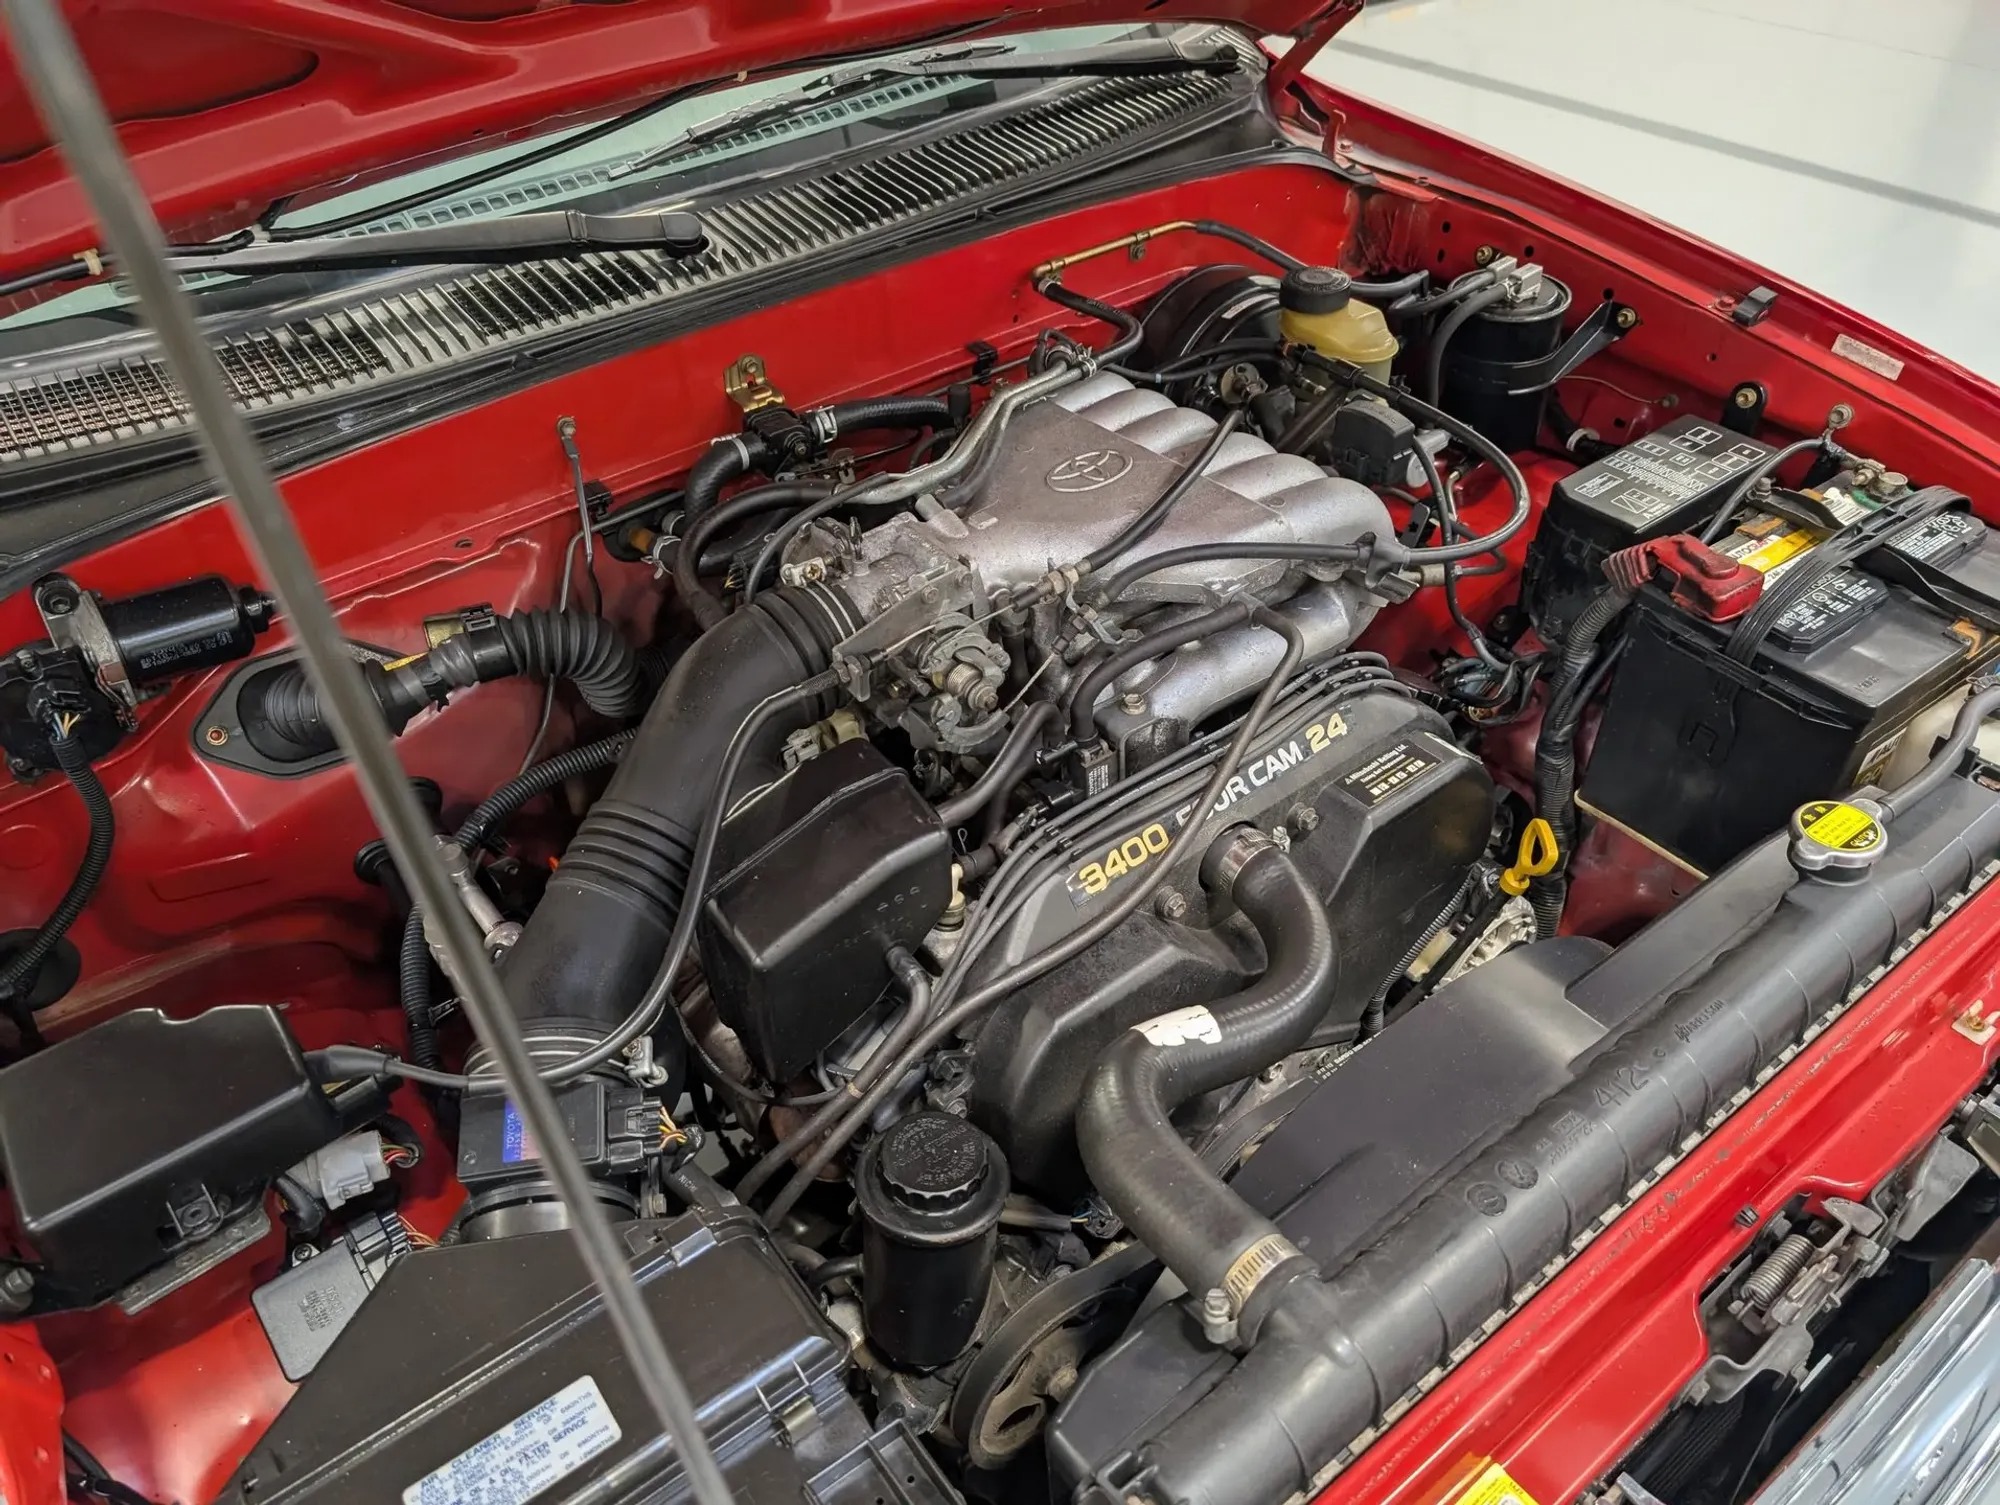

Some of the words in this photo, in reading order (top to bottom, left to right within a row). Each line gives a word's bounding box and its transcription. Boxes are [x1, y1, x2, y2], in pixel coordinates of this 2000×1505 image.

[1078, 822, 1171, 894] 3400
[1175, 777, 1250, 828] FUR
[1248, 741, 1304, 787] CAM
[1305, 712, 1348, 754] 24
[506, 1112, 516, 1150] TOYOTA
[419, 1472, 439, 1489] AIR
[450, 1432, 502, 1469] CLEANER
[512, 1396, 557, 1429] SERVICE
[517, 1440, 550, 1465] FILTER
[551, 1415, 588, 1443] SERVICE
